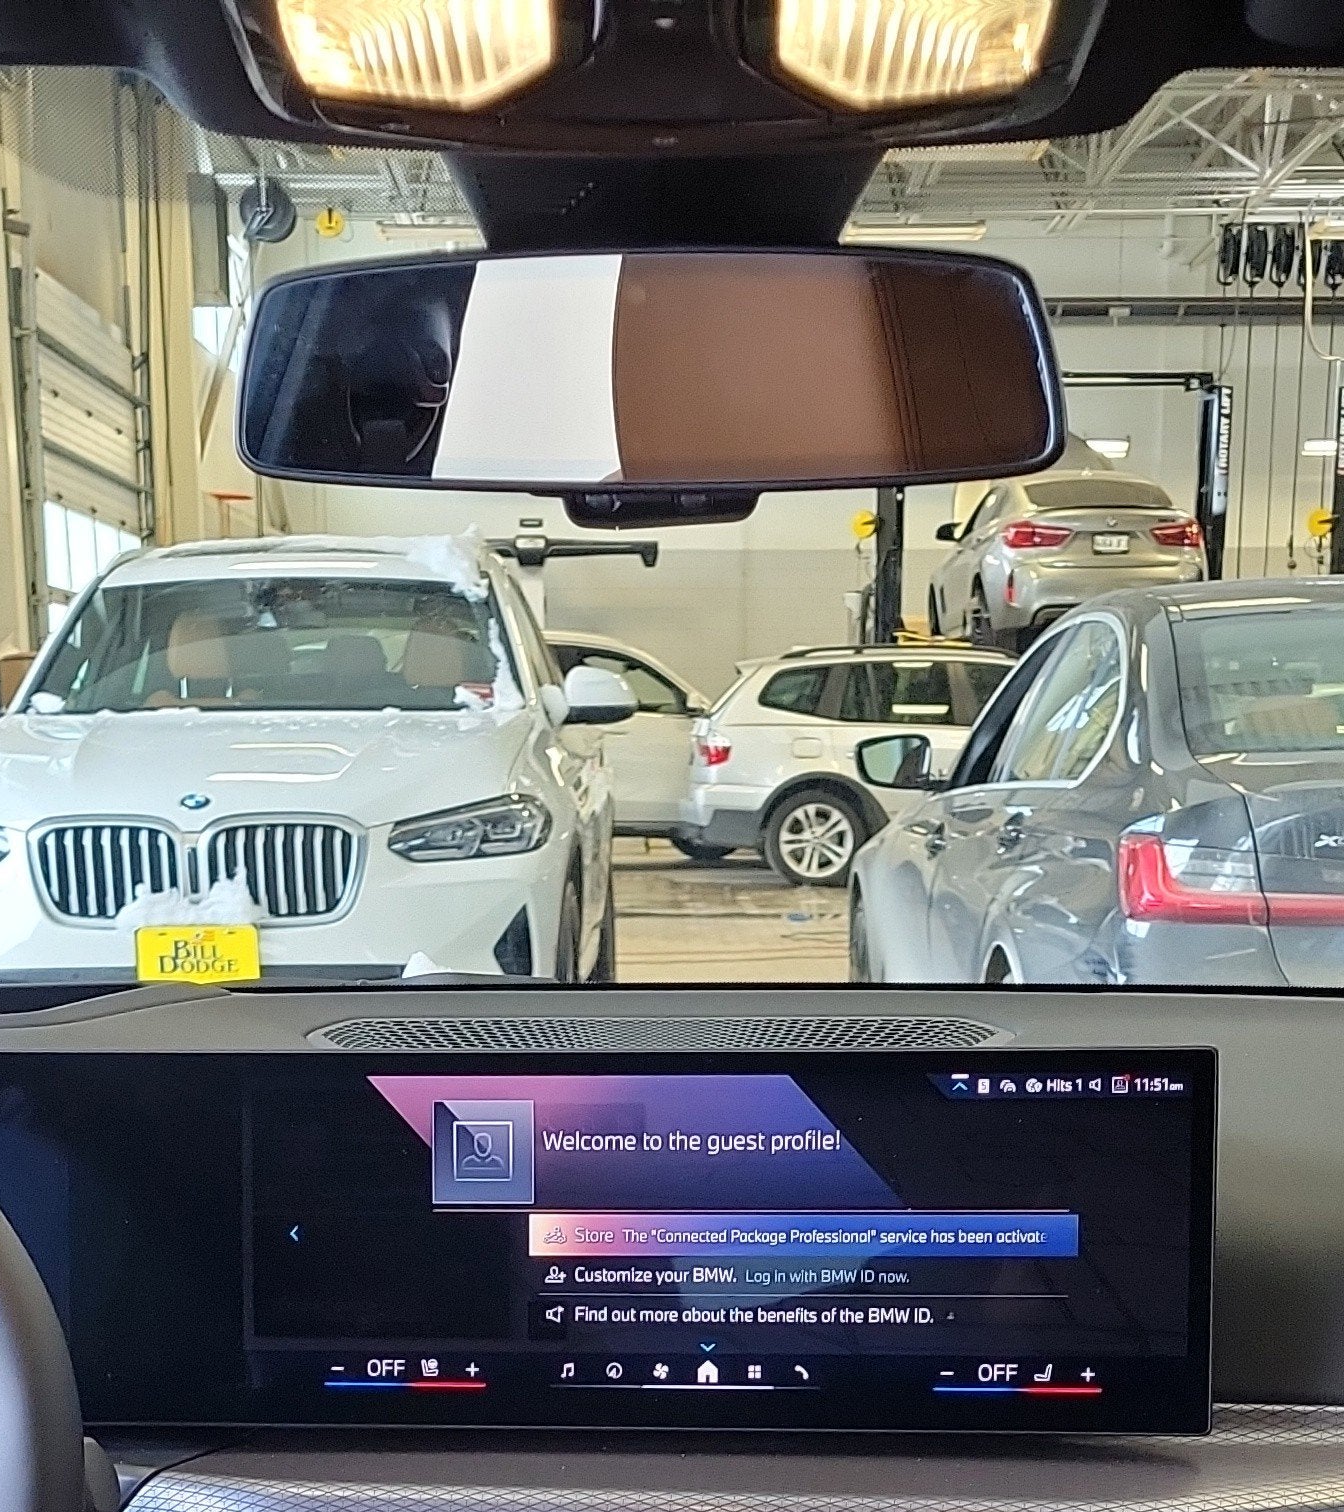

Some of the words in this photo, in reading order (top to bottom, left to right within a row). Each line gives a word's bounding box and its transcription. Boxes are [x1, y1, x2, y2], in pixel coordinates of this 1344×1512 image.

[174, 940, 224, 960] BILL
[159, 955, 240, 974] DODGE
[1046, 1078, 1073, 1092] Hits
[1076, 1078, 1083, 1092] 1
[542, 1130, 638, 1152] Welcome
[642, 1133, 663, 1152] to
[668, 1130, 702, 1152] the
[707, 1131, 766, 1155] guest
[771, 1130, 842, 1155] profile!
[574, 1226, 615, 1244] Store
[622, 1229, 648, 1244] The
[651, 1228, 728, 1244] "Connected
[730, 1229, 787, 1246] Package
[790, 1229, 877, 1244] Professional"
[879, 1231, 927, 1244] service
[930, 1229, 955, 1244] has
[958, 1229, 993, 1244] been
[574, 1267, 653, 1284] Customize
[656, 1271, 690, 1286] your
[692, 1267, 738, 1283] BMW.
[745, 1269, 771, 1286] Log
[774, 1269, 787, 1283] in
[789, 1270, 817, 1283] with
[820, 1270, 857, 1284] BMW
[860, 1270, 875, 1284] ID
[878, 1271, 910, 1285] now.
[574, 1306, 608, 1323] Find
[611, 1307, 637, 1323] out
[639, 1309, 679, 1323] more
[682, 1307, 726, 1323] about
[729, 1307, 754, 1323] the
[757, 1307, 818, 1324] benefits
[820, 1307, 837, 1324] of
[839, 1307, 865, 1324] the
[868, 1307, 910, 1324] BMW
[913, 1307, 935, 1324] ID.
[367, 1359, 406, 1377] OFF
[977, 1363, 1019, 1382] OFF
